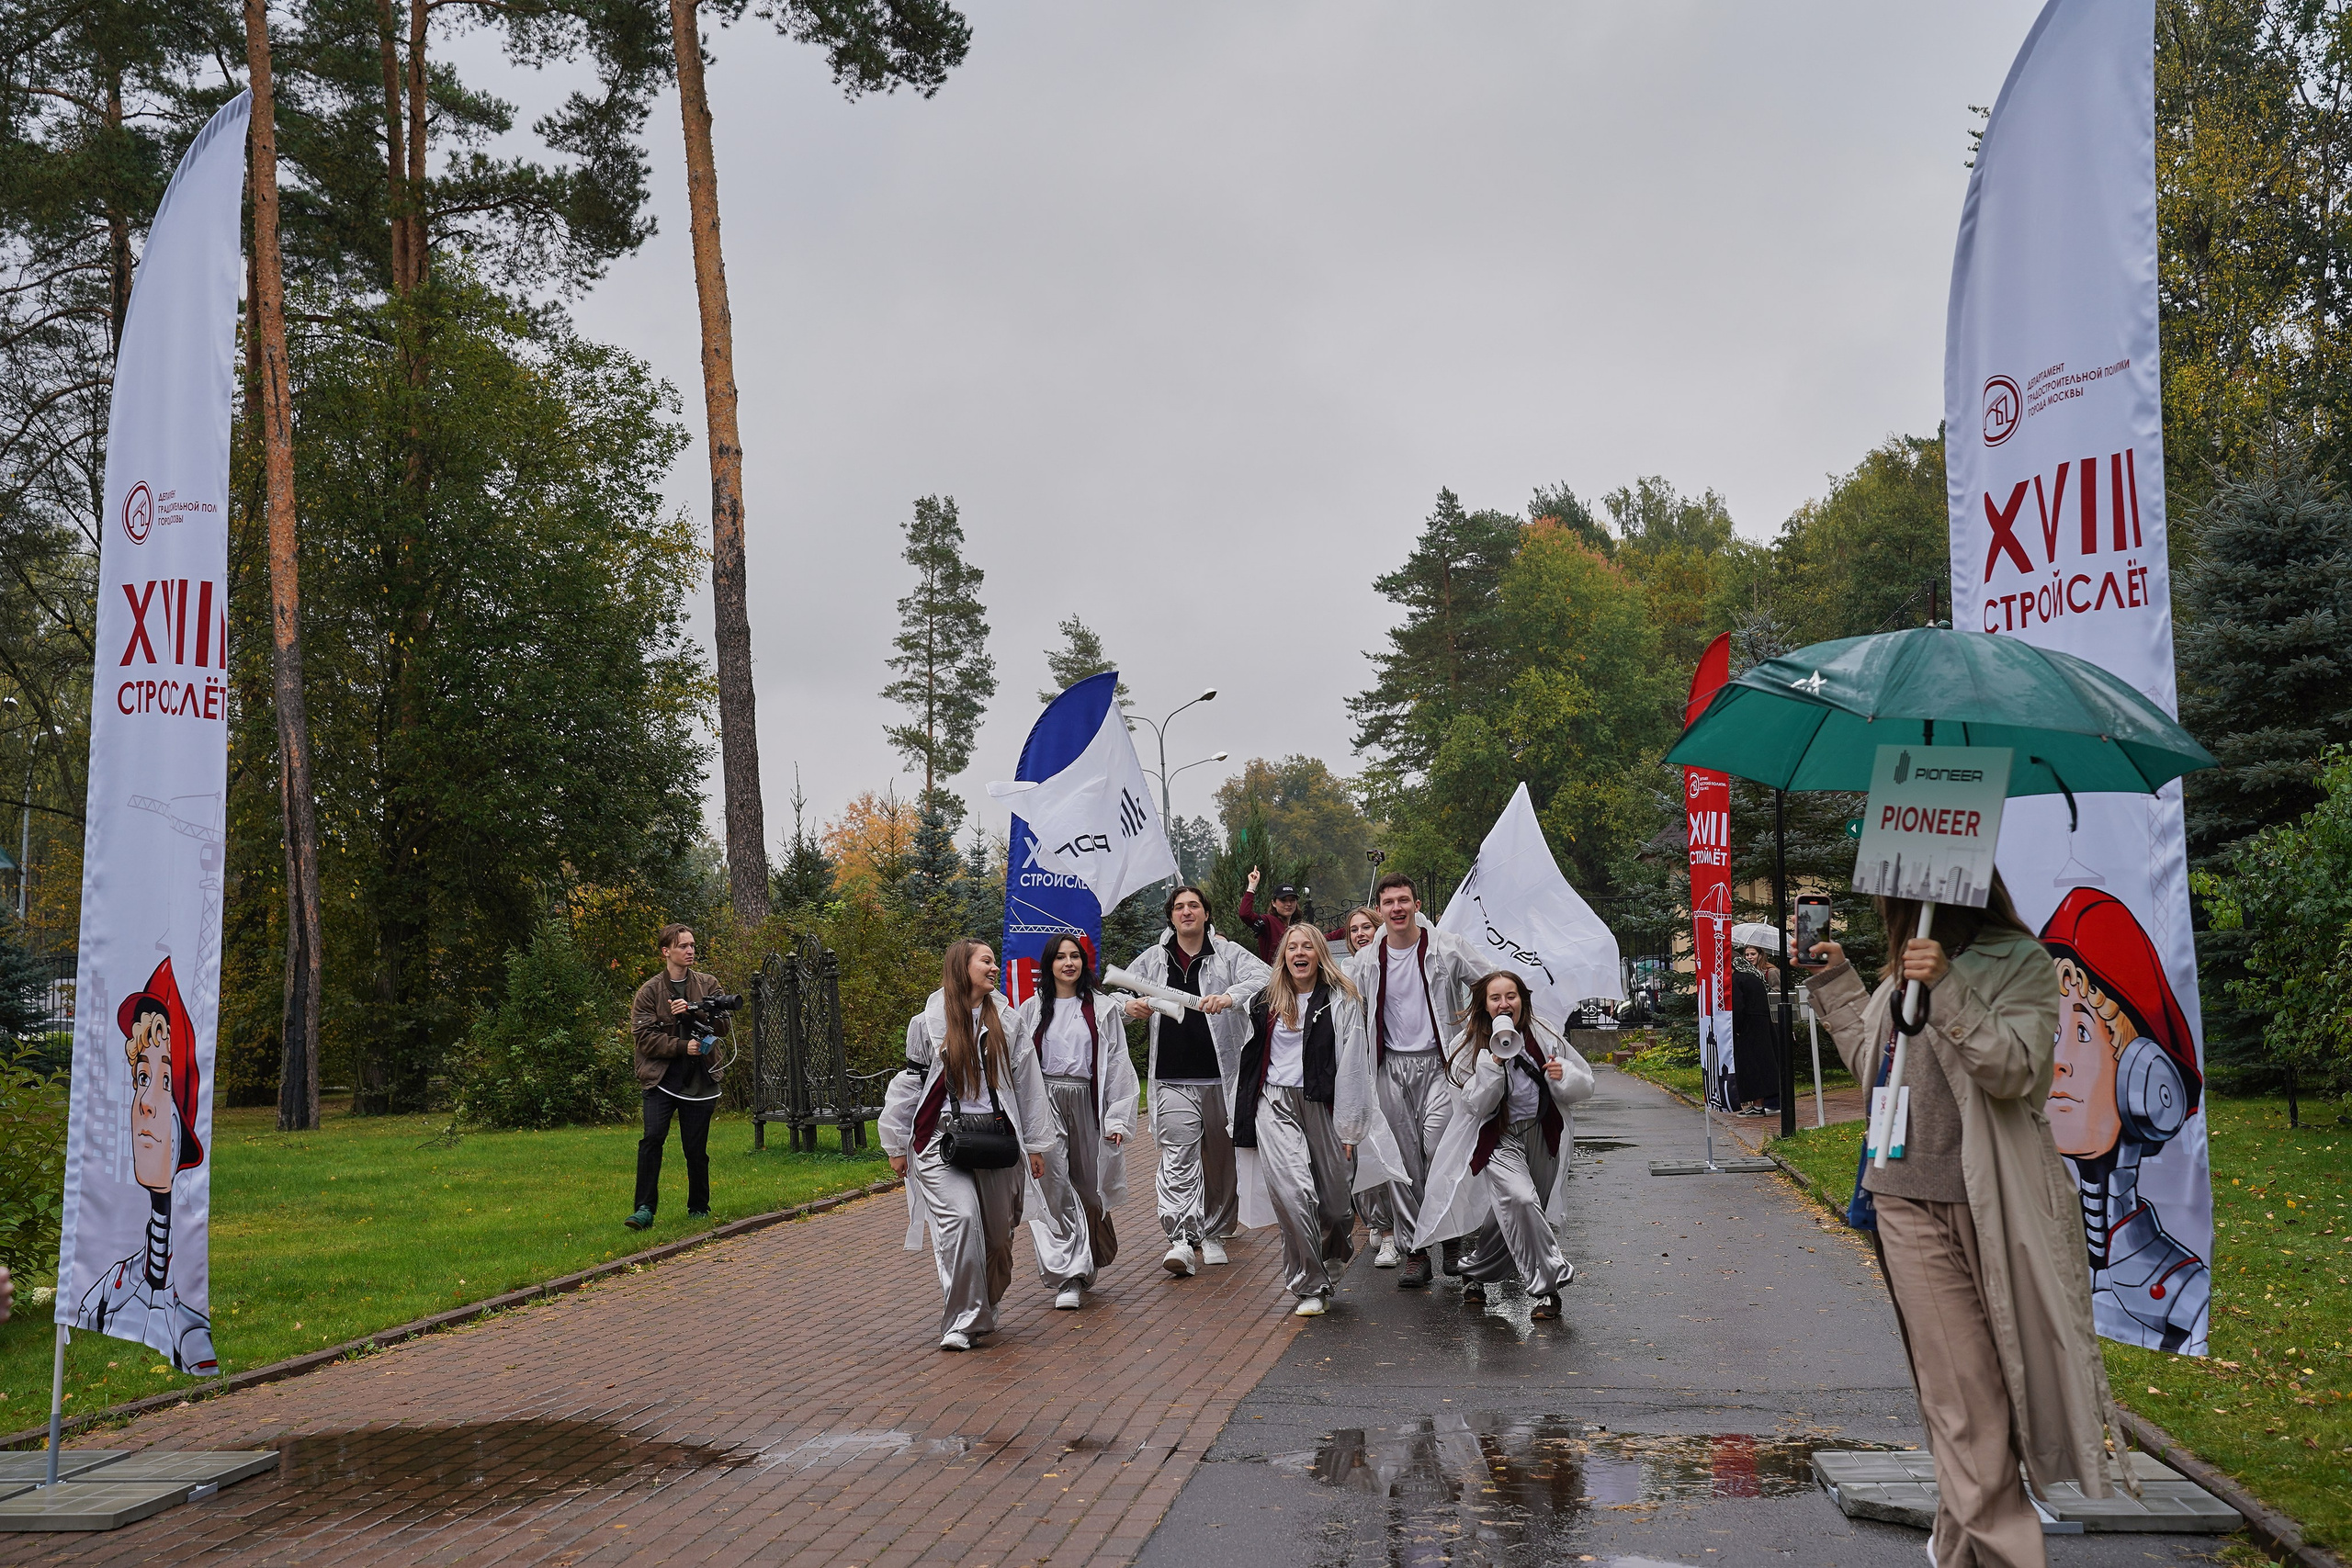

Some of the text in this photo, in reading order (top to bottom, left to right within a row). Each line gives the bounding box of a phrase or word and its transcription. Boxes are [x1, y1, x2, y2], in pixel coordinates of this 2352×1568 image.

[2027, 362, 2064, 391] ДЕПАРТАМЕНТ
[2027, 367, 2103, 404] ГРАДОСТРОИТЕЛЬНОЙ
[2028, 387, 2084, 418] ГОРОДА МОСКВЫ
[1984, 448, 2143, 584] XVIII
[1984, 558, 2149, 635] СТРОЙСЛЁТ
[1915, 767, 1984, 783] PIONEER
[1881, 805, 1981, 837] PIONEER
